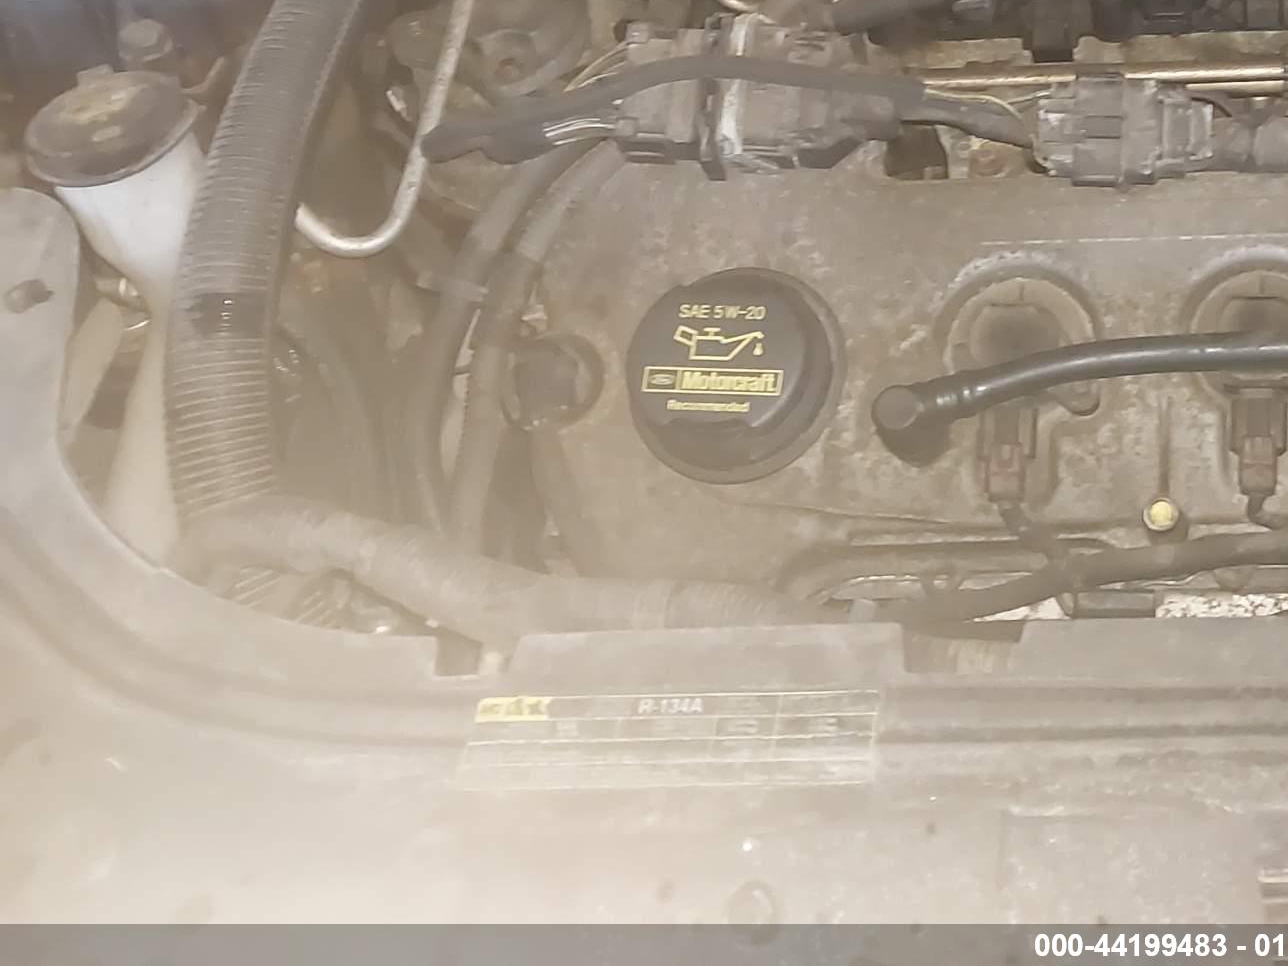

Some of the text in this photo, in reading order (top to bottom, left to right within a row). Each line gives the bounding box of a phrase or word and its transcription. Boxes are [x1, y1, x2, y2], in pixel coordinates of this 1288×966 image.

[678, 303, 767, 321] SAE 5W-20
[681, 370, 776, 393] Motorcraft
[637, 698, 705, 714] R-134A
